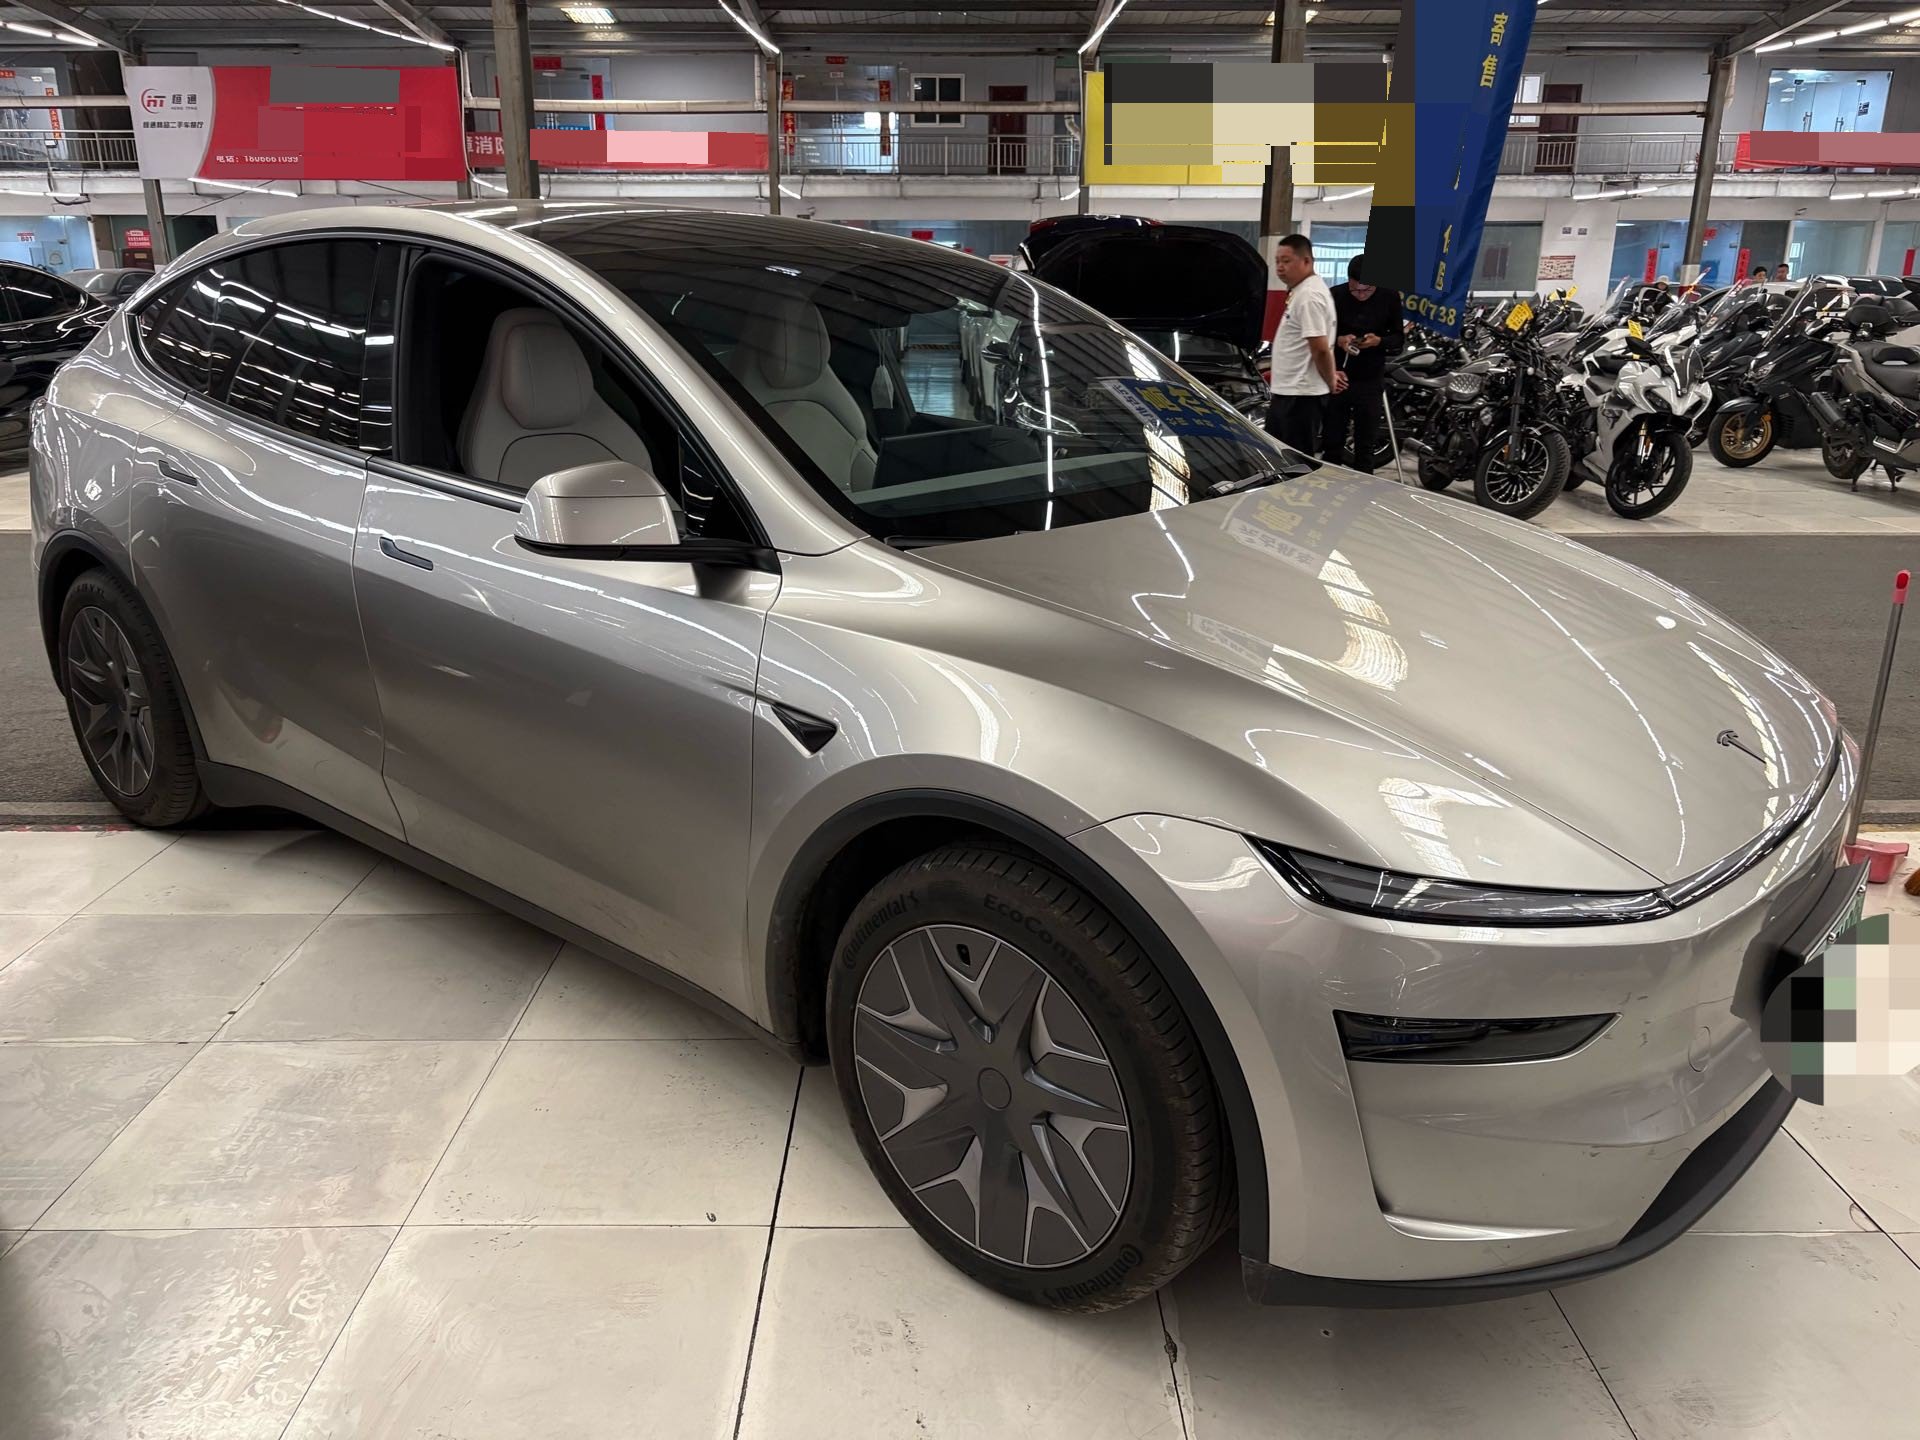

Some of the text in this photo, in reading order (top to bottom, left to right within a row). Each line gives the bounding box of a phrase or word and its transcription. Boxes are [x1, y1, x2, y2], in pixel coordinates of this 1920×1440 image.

[171, 93, 198, 105] 恒通
[842, 893, 908, 970] Continental
[1055, 1244, 1144, 1305] Continental
